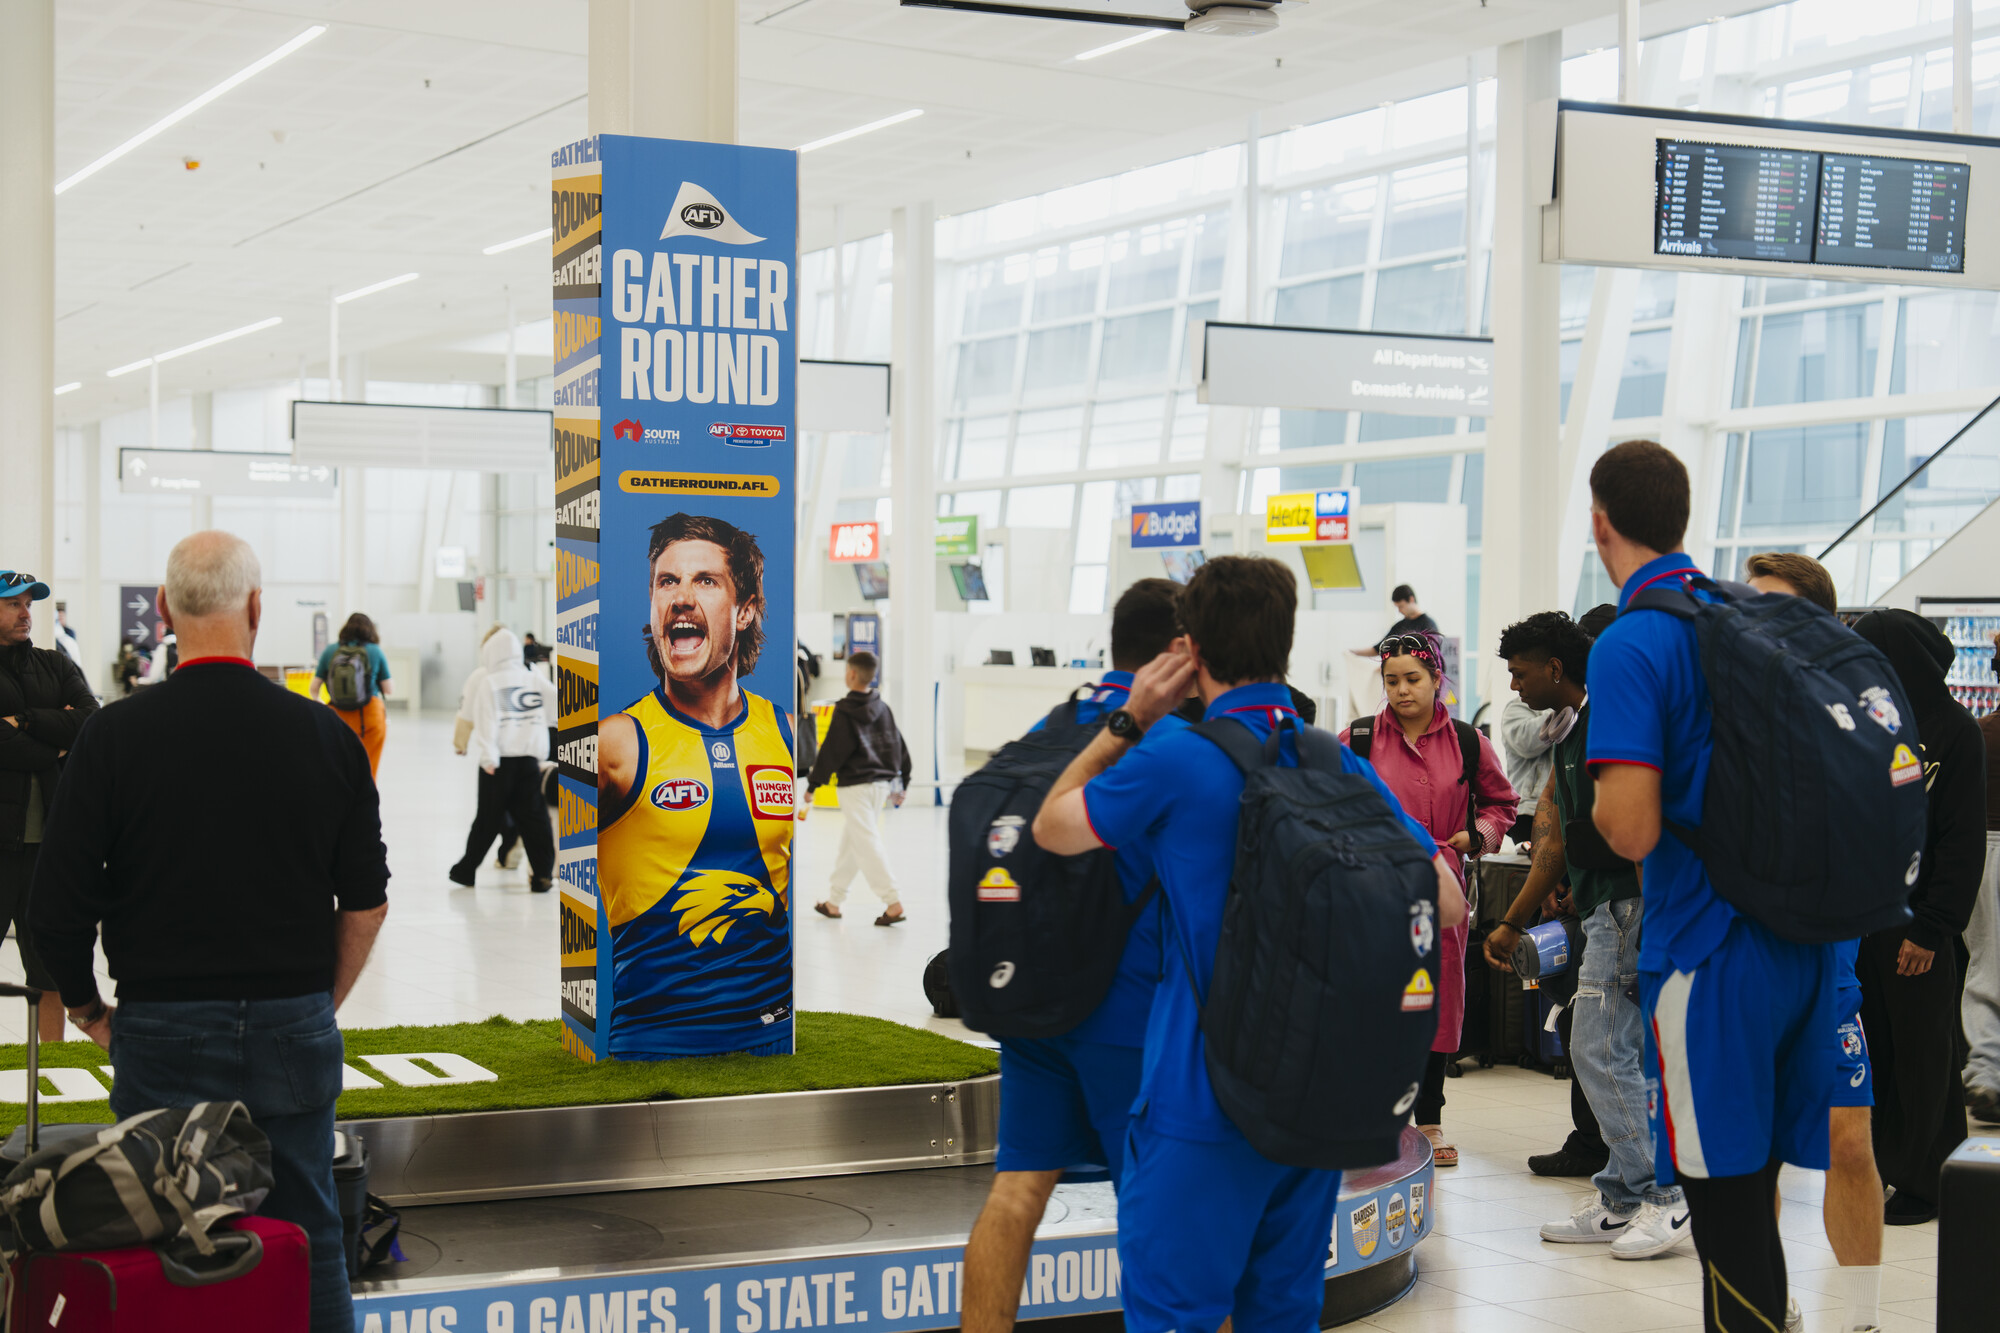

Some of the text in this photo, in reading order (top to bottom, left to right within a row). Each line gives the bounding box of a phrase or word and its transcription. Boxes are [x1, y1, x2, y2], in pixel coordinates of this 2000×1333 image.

[552, 190, 602, 245] ROUND
[685, 209, 721, 224] AFL
[553, 244, 601, 286] GATHER
[1660, 239, 1702, 254] Arrivals
[612, 249, 788, 331] GATHER
[553, 310, 601, 365] ROUND
[621, 327, 779, 406] ROUND
[1373, 349, 1465, 370] All Departures
[554, 368, 600, 406] GATHER
[1352, 380, 1465, 400] Domestic Arrivals
[644, 429, 680, 439] SOUTH
[709, 426, 731, 434] AFL
[555, 428, 600, 482] ROUND
[630, 477, 768, 491] GATHERROUND.AFL
[556, 489, 600, 529] GATHER
[1150, 510, 1197, 542] Budget
[1270, 504, 1310, 526] Hertz
[556, 547, 600, 602] ROUND
[557, 613, 599, 652] GATHER
[557, 665, 599, 719] ROUND
[558, 734, 598, 774] GATHER
[656, 785, 705, 804] AFL
[756, 783, 791, 792] HUNGRY
[558, 783, 598, 838] ROUND
[560, 858, 597, 897] GATHER
[561, 900, 596, 955] ROUND
[561, 979, 596, 1019] GATHER
[1354, 1203, 1376, 1225] BAROSSA
[704, 1283, 720, 1333] 1
[736, 1271, 868, 1333] STATE.
[882, 1262, 964, 1320] GAT
